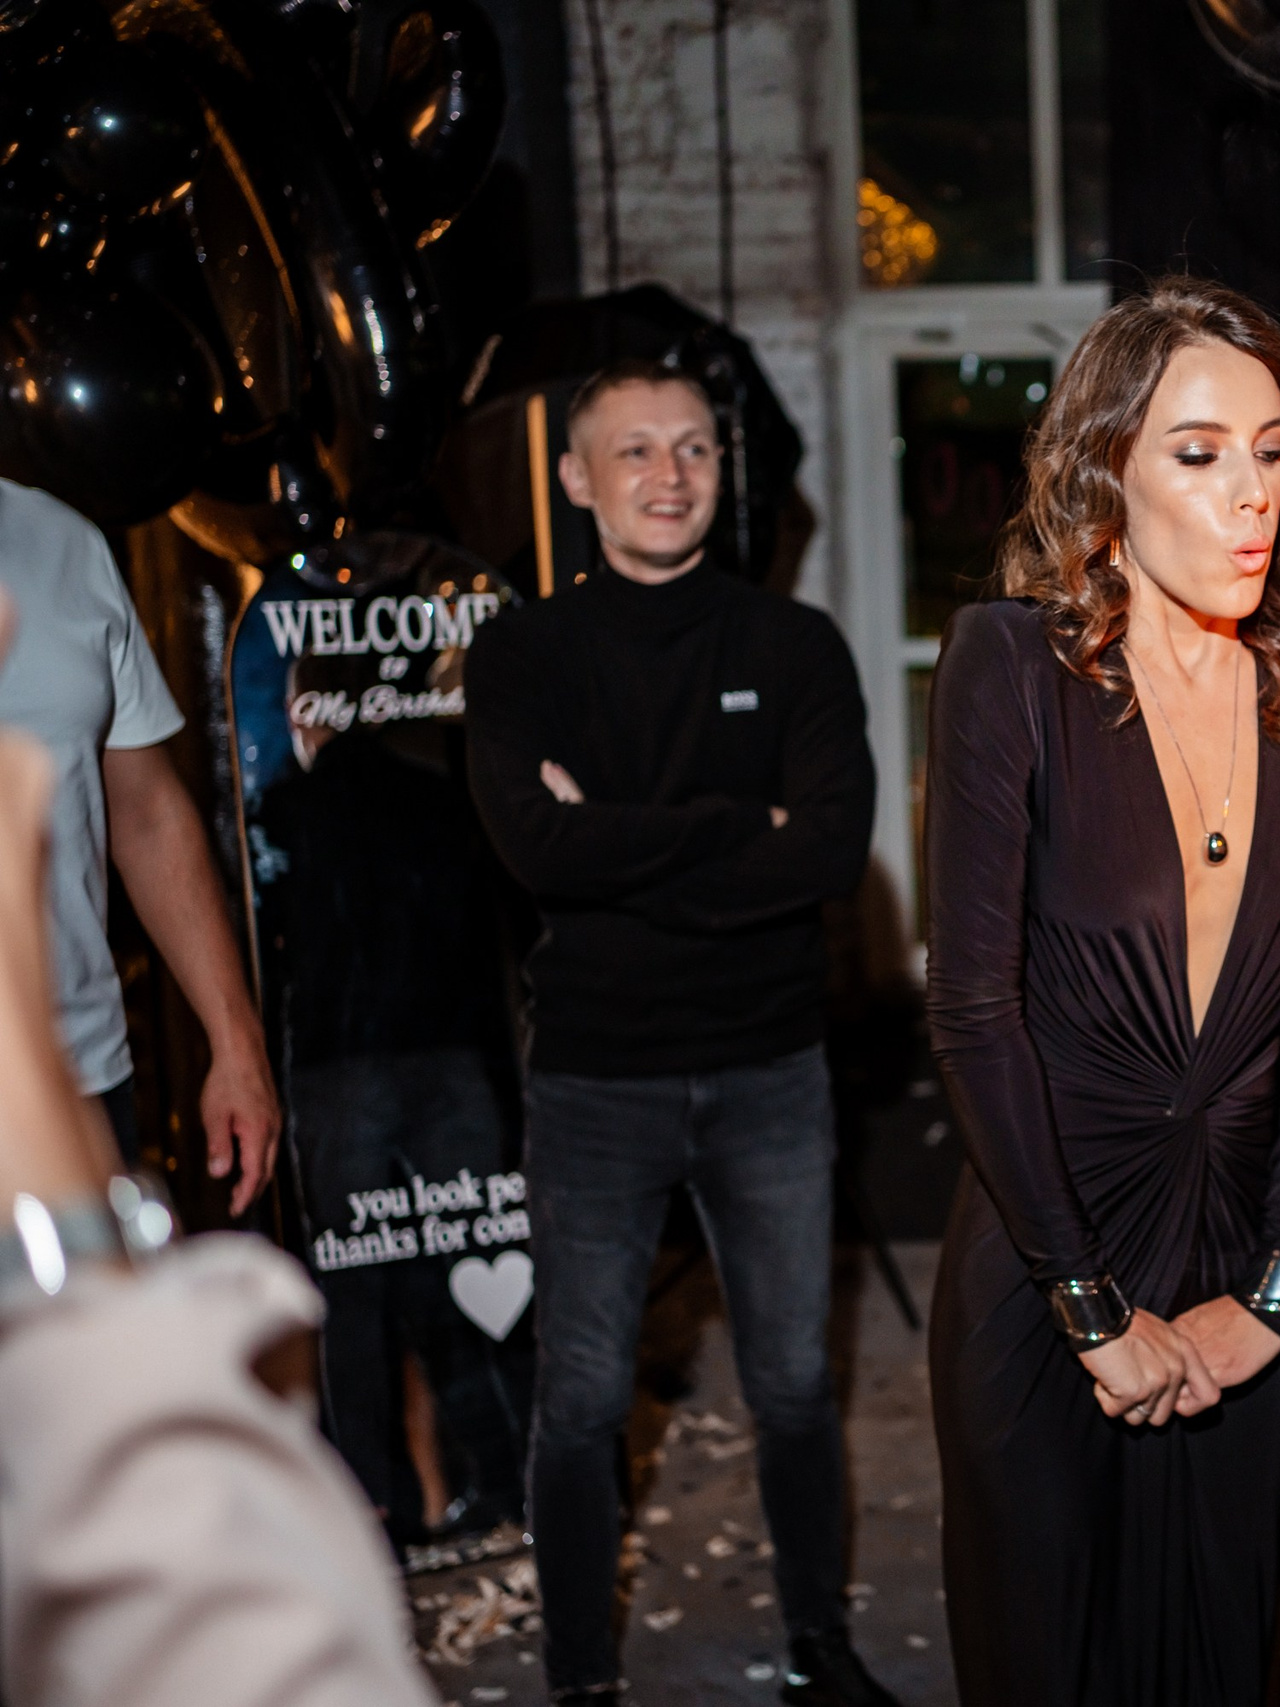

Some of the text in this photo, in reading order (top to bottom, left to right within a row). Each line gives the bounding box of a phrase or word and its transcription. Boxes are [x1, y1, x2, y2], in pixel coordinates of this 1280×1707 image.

[289, 690, 357, 733] My
[347, 1167, 526, 1233] you look pe
[313, 1220, 419, 1271] thanks
[421, 1215, 469, 1256] for
